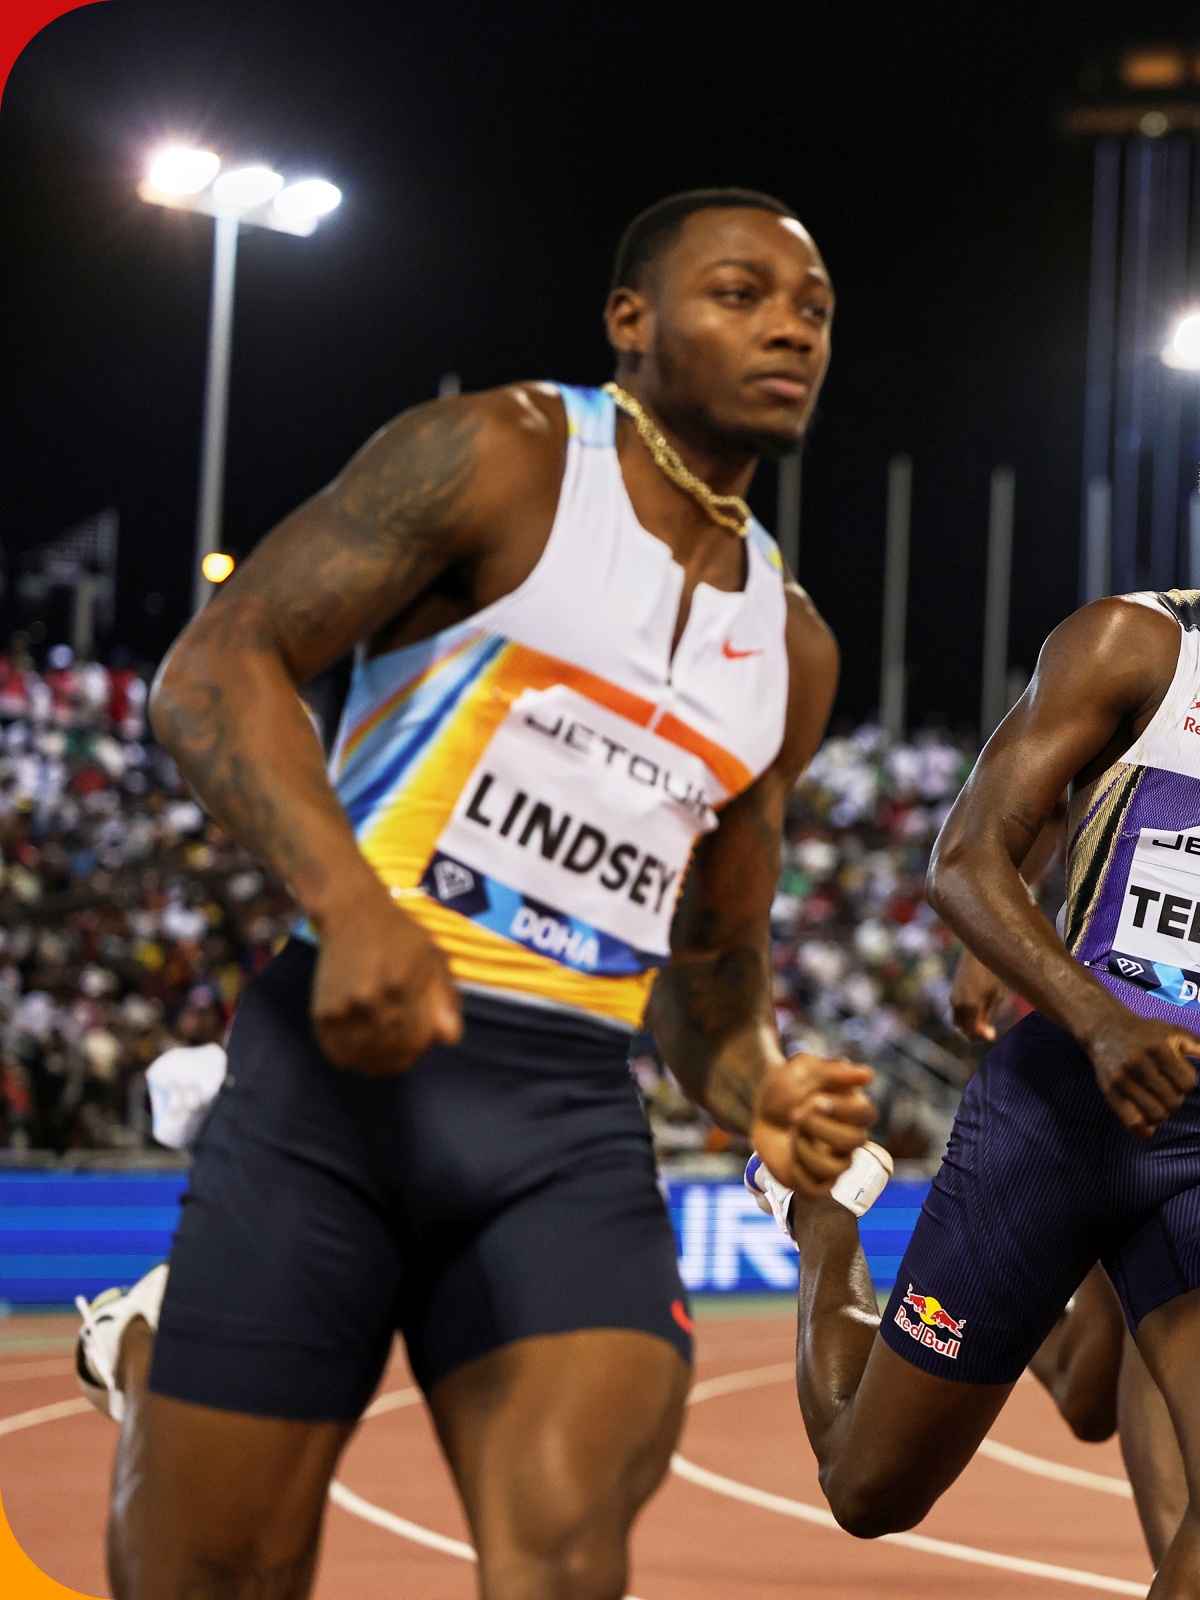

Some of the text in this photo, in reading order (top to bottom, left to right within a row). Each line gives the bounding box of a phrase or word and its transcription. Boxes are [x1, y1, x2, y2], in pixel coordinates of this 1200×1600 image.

[466, 774, 675, 914] LINDSEY
[511, 908, 600, 969] DOHA
[894, 1305, 960, 1359] Red Bull
